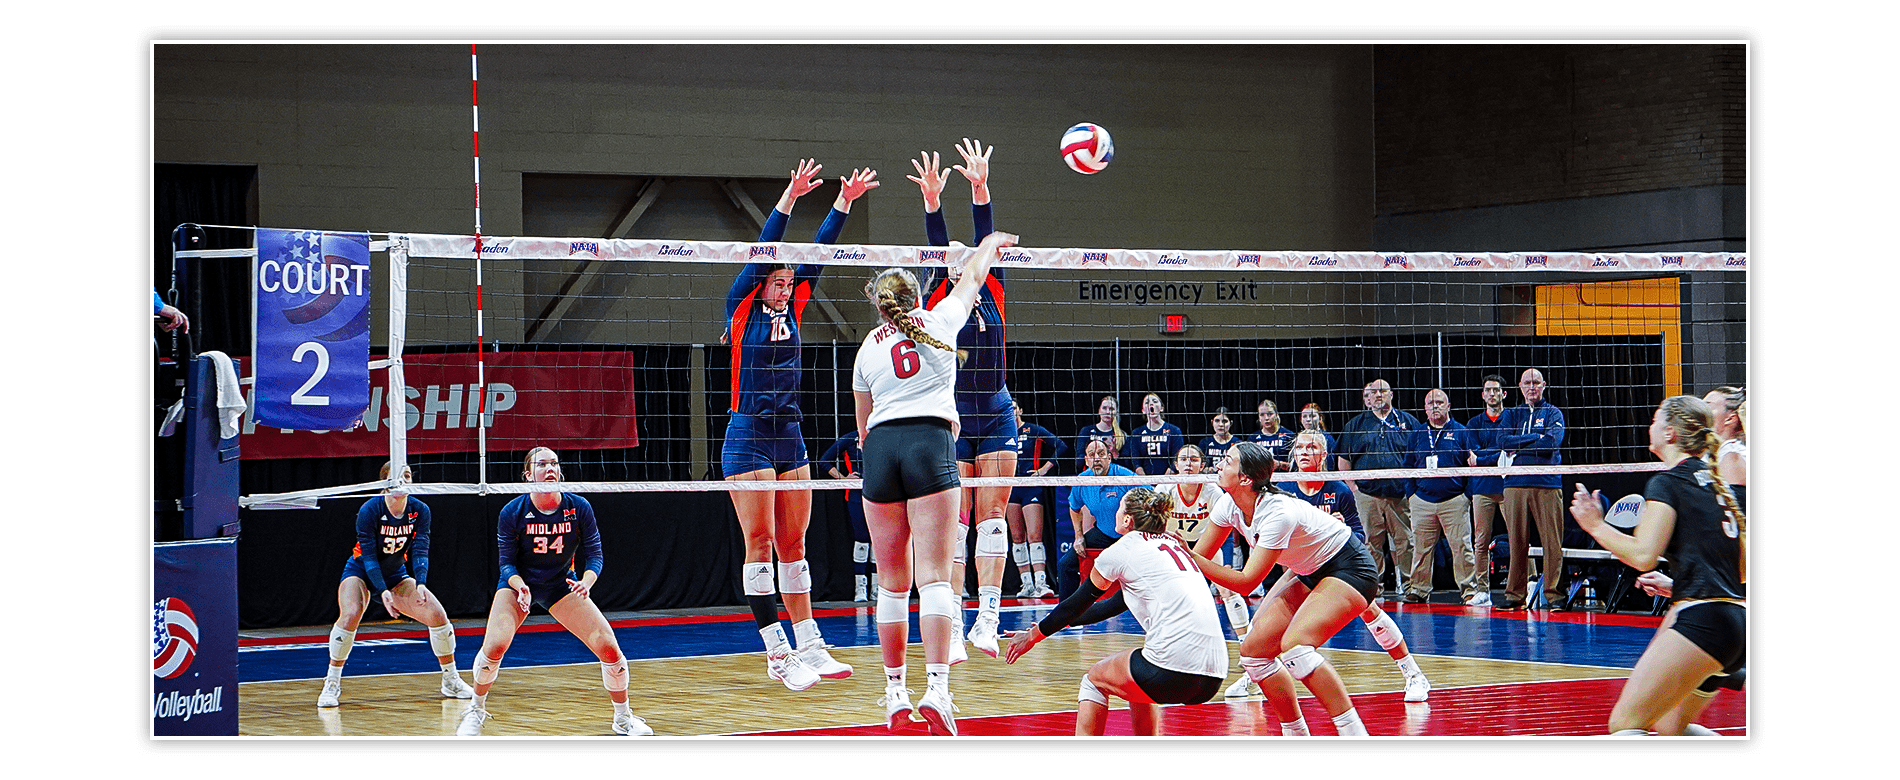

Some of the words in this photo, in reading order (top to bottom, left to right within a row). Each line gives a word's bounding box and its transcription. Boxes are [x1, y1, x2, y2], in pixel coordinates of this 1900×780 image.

[569, 241, 598, 256] NAIA
[658, 244, 693, 257] Baden
[750, 246, 777, 260] NAIA
[833, 249, 866, 261] Baden
[920, 250, 947, 265] NAIA
[1000, 251, 1032, 263] Baden
[1082, 252, 1108, 265] NAIA
[1158, 254, 1188, 265] Baden
[1236, 254, 1261, 267] NAIA
[1308, 256, 1338, 266] Baden
[1384, 256, 1408, 268] NAIA
[1453, 256, 1482, 267] Baden
[1525, 256, 1548, 268] NAIA
[1592, 257, 1619, 267] Baden
[1661, 256, 1683, 268] NAIA
[259, 259, 370, 297] COURT
[1079, 280, 1204, 305] Emergency
[1216, 277, 1258, 300] Exit
[891, 339, 921, 379] 6
[290, 341, 331, 406] 2
[242, 382, 517, 435] NSHIP
[1147, 442, 1161, 455] 21
[1613, 501, 1641, 517] NAIA
[380, 524, 414, 536] MIDLAND
[526, 522, 572, 535] MIDLAND
[1177, 519, 1199, 533] 17
[532, 535, 565, 554] 34
